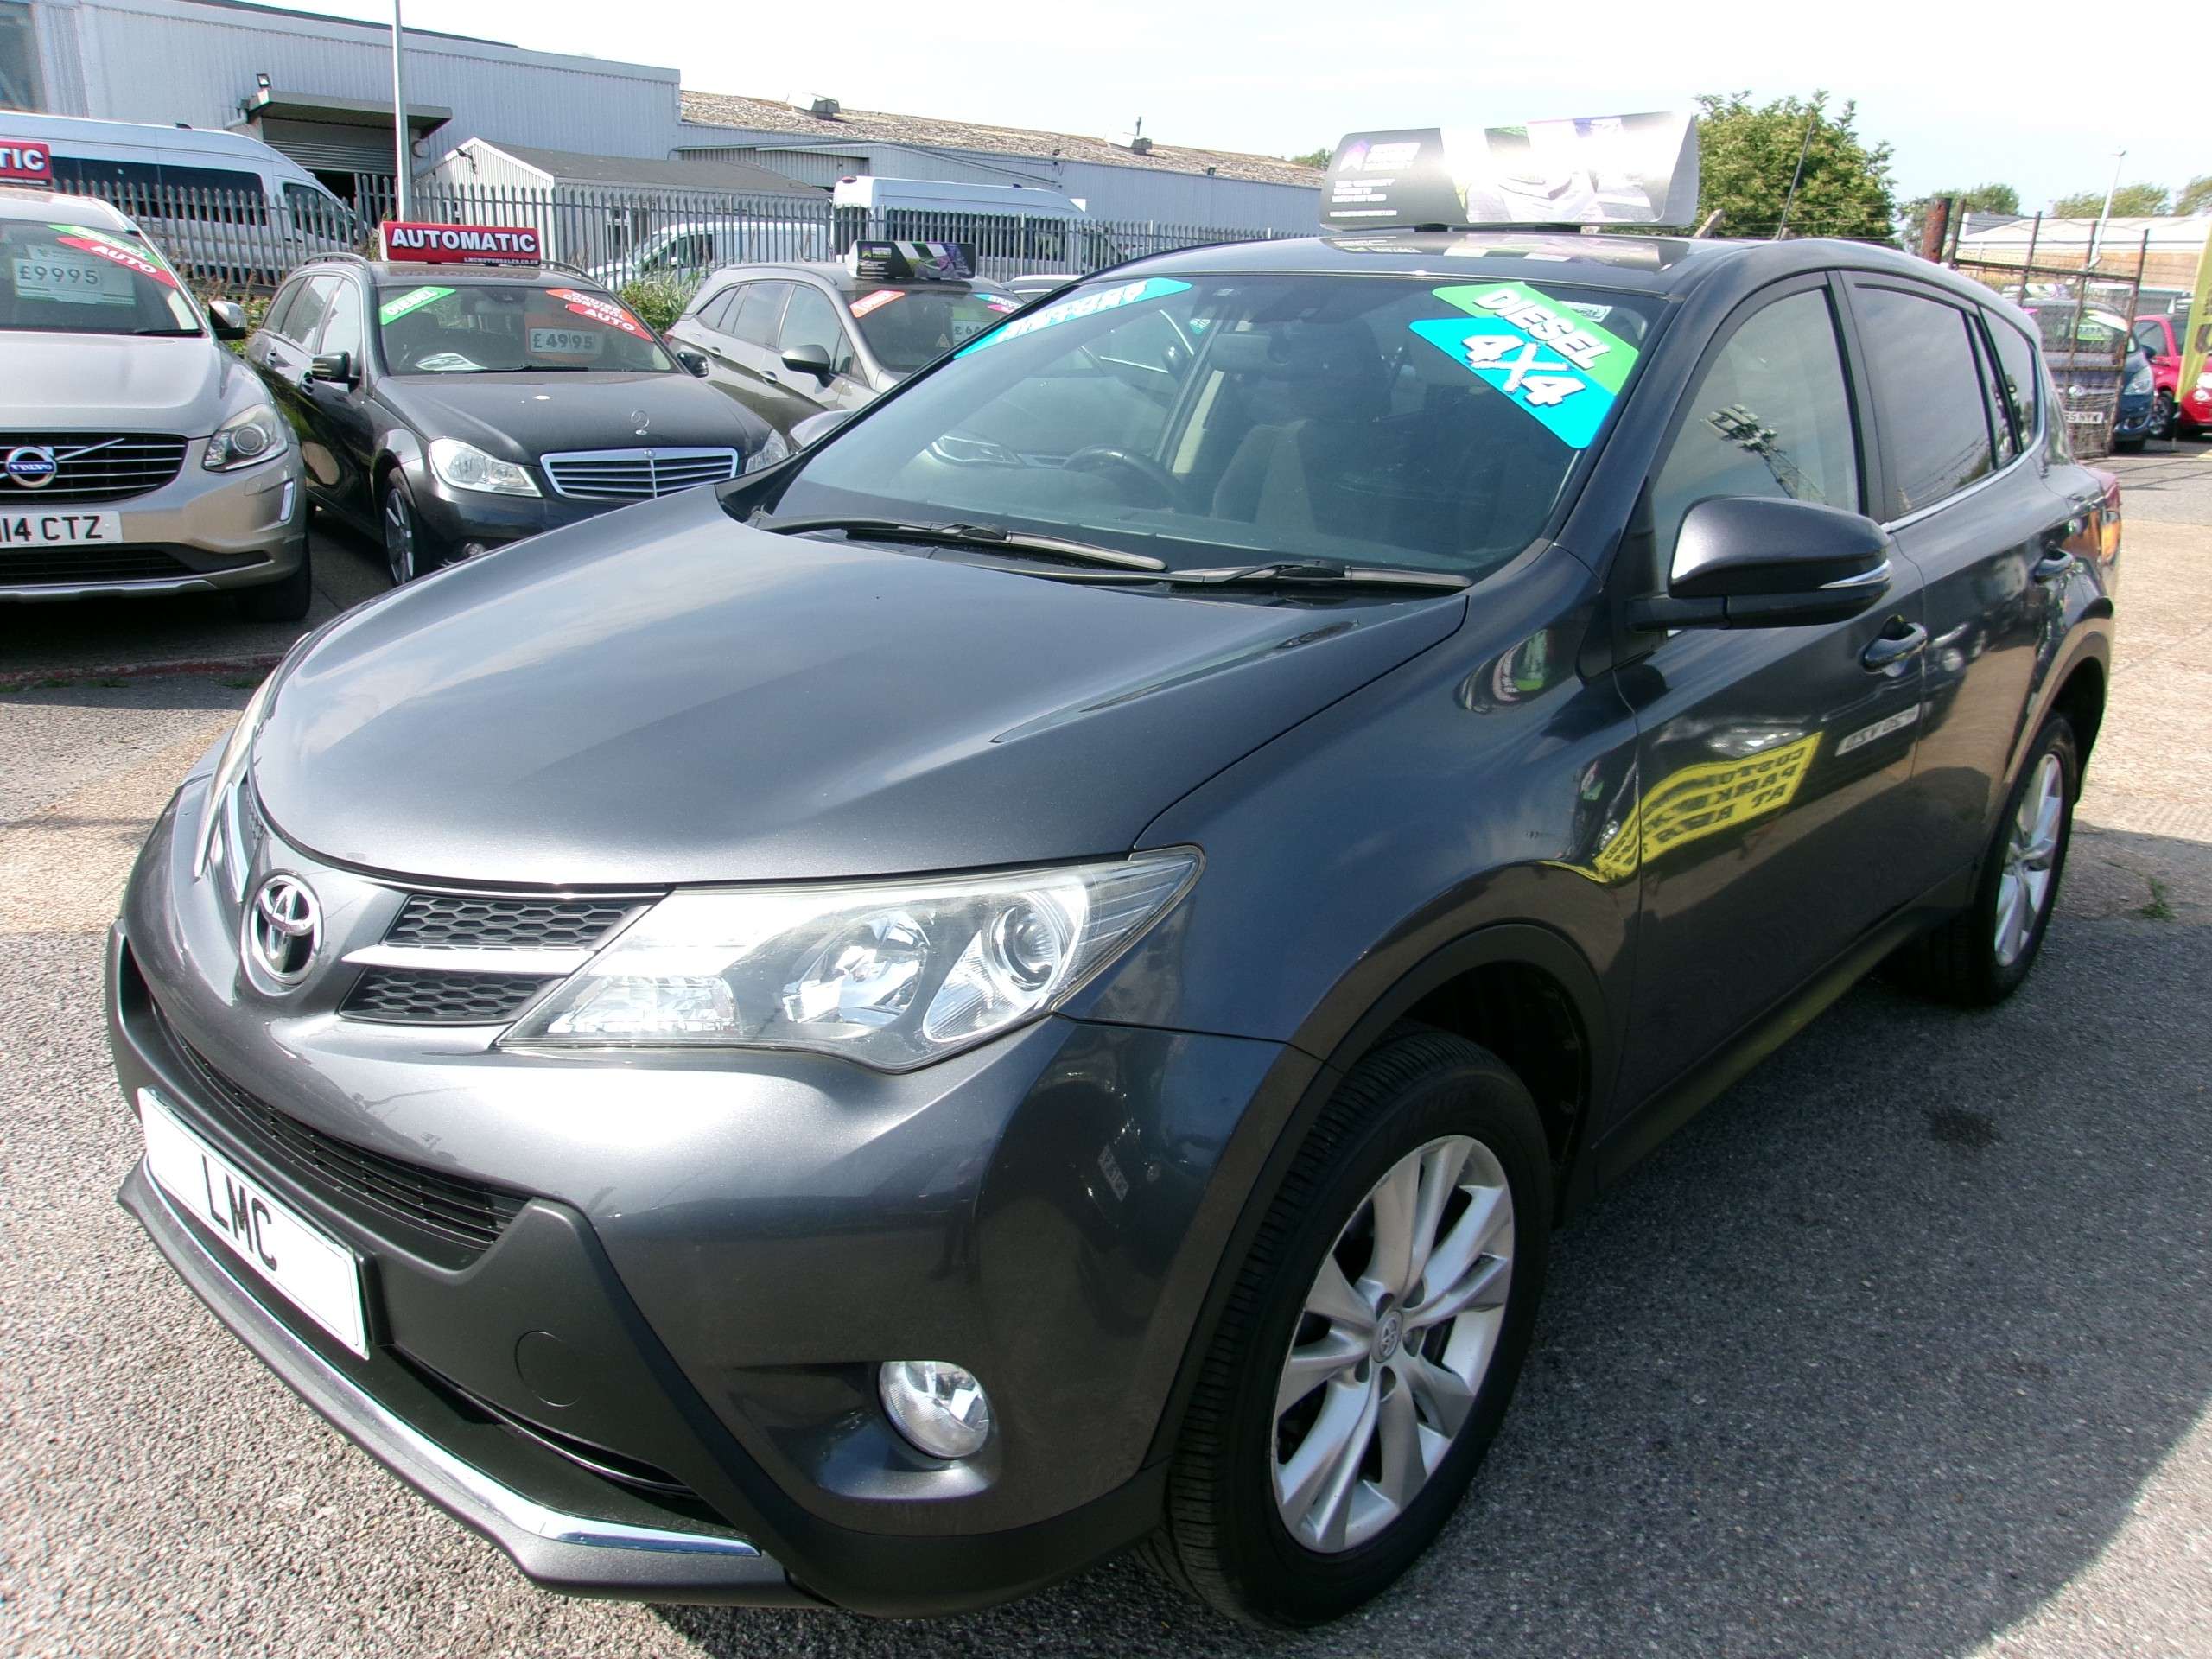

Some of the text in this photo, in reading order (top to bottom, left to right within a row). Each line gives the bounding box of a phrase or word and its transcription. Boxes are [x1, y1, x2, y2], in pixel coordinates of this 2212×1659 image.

[391, 228, 537, 253] AUTOMATIC
[90, 245, 157, 274] AUTO
[19, 266, 99, 285] £9995
[582, 308, 636, 331] AUTO
[1472, 288, 1611, 371] DIESEL
[1462, 334, 1587, 407] 4X4
[41, 515, 103, 541] CTZ
[201, 1154, 277, 1272] LMC
